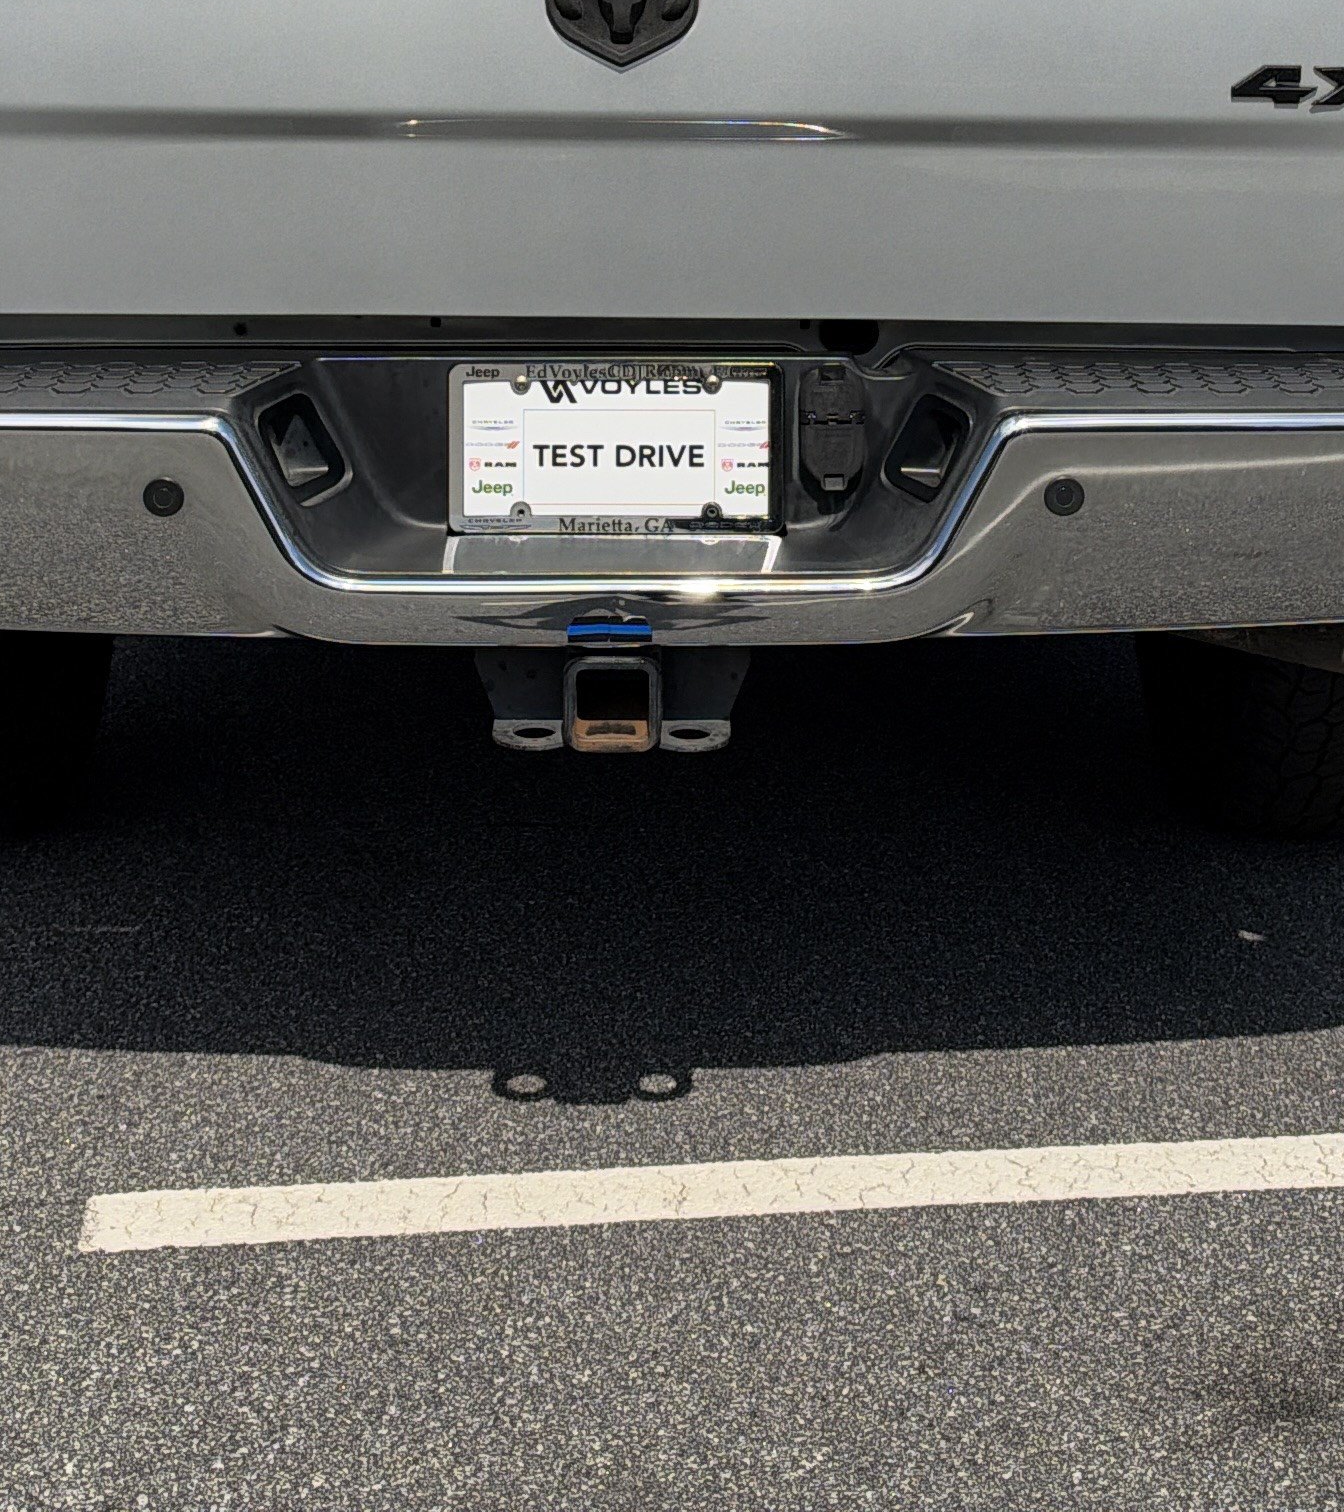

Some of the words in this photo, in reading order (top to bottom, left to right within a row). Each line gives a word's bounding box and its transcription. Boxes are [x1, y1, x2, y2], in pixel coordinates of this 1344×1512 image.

[465, 366, 500, 379] Jeep
[578, 378, 703, 395] VOYLES
[532, 444, 605, 468] TEST
[615, 444, 705, 468] DRIVE
[471, 479, 514, 497] Jeep
[724, 479, 766, 497] Jeep
[558, 516, 641, 534] Marietta,
[644, 517, 675, 533] GA
